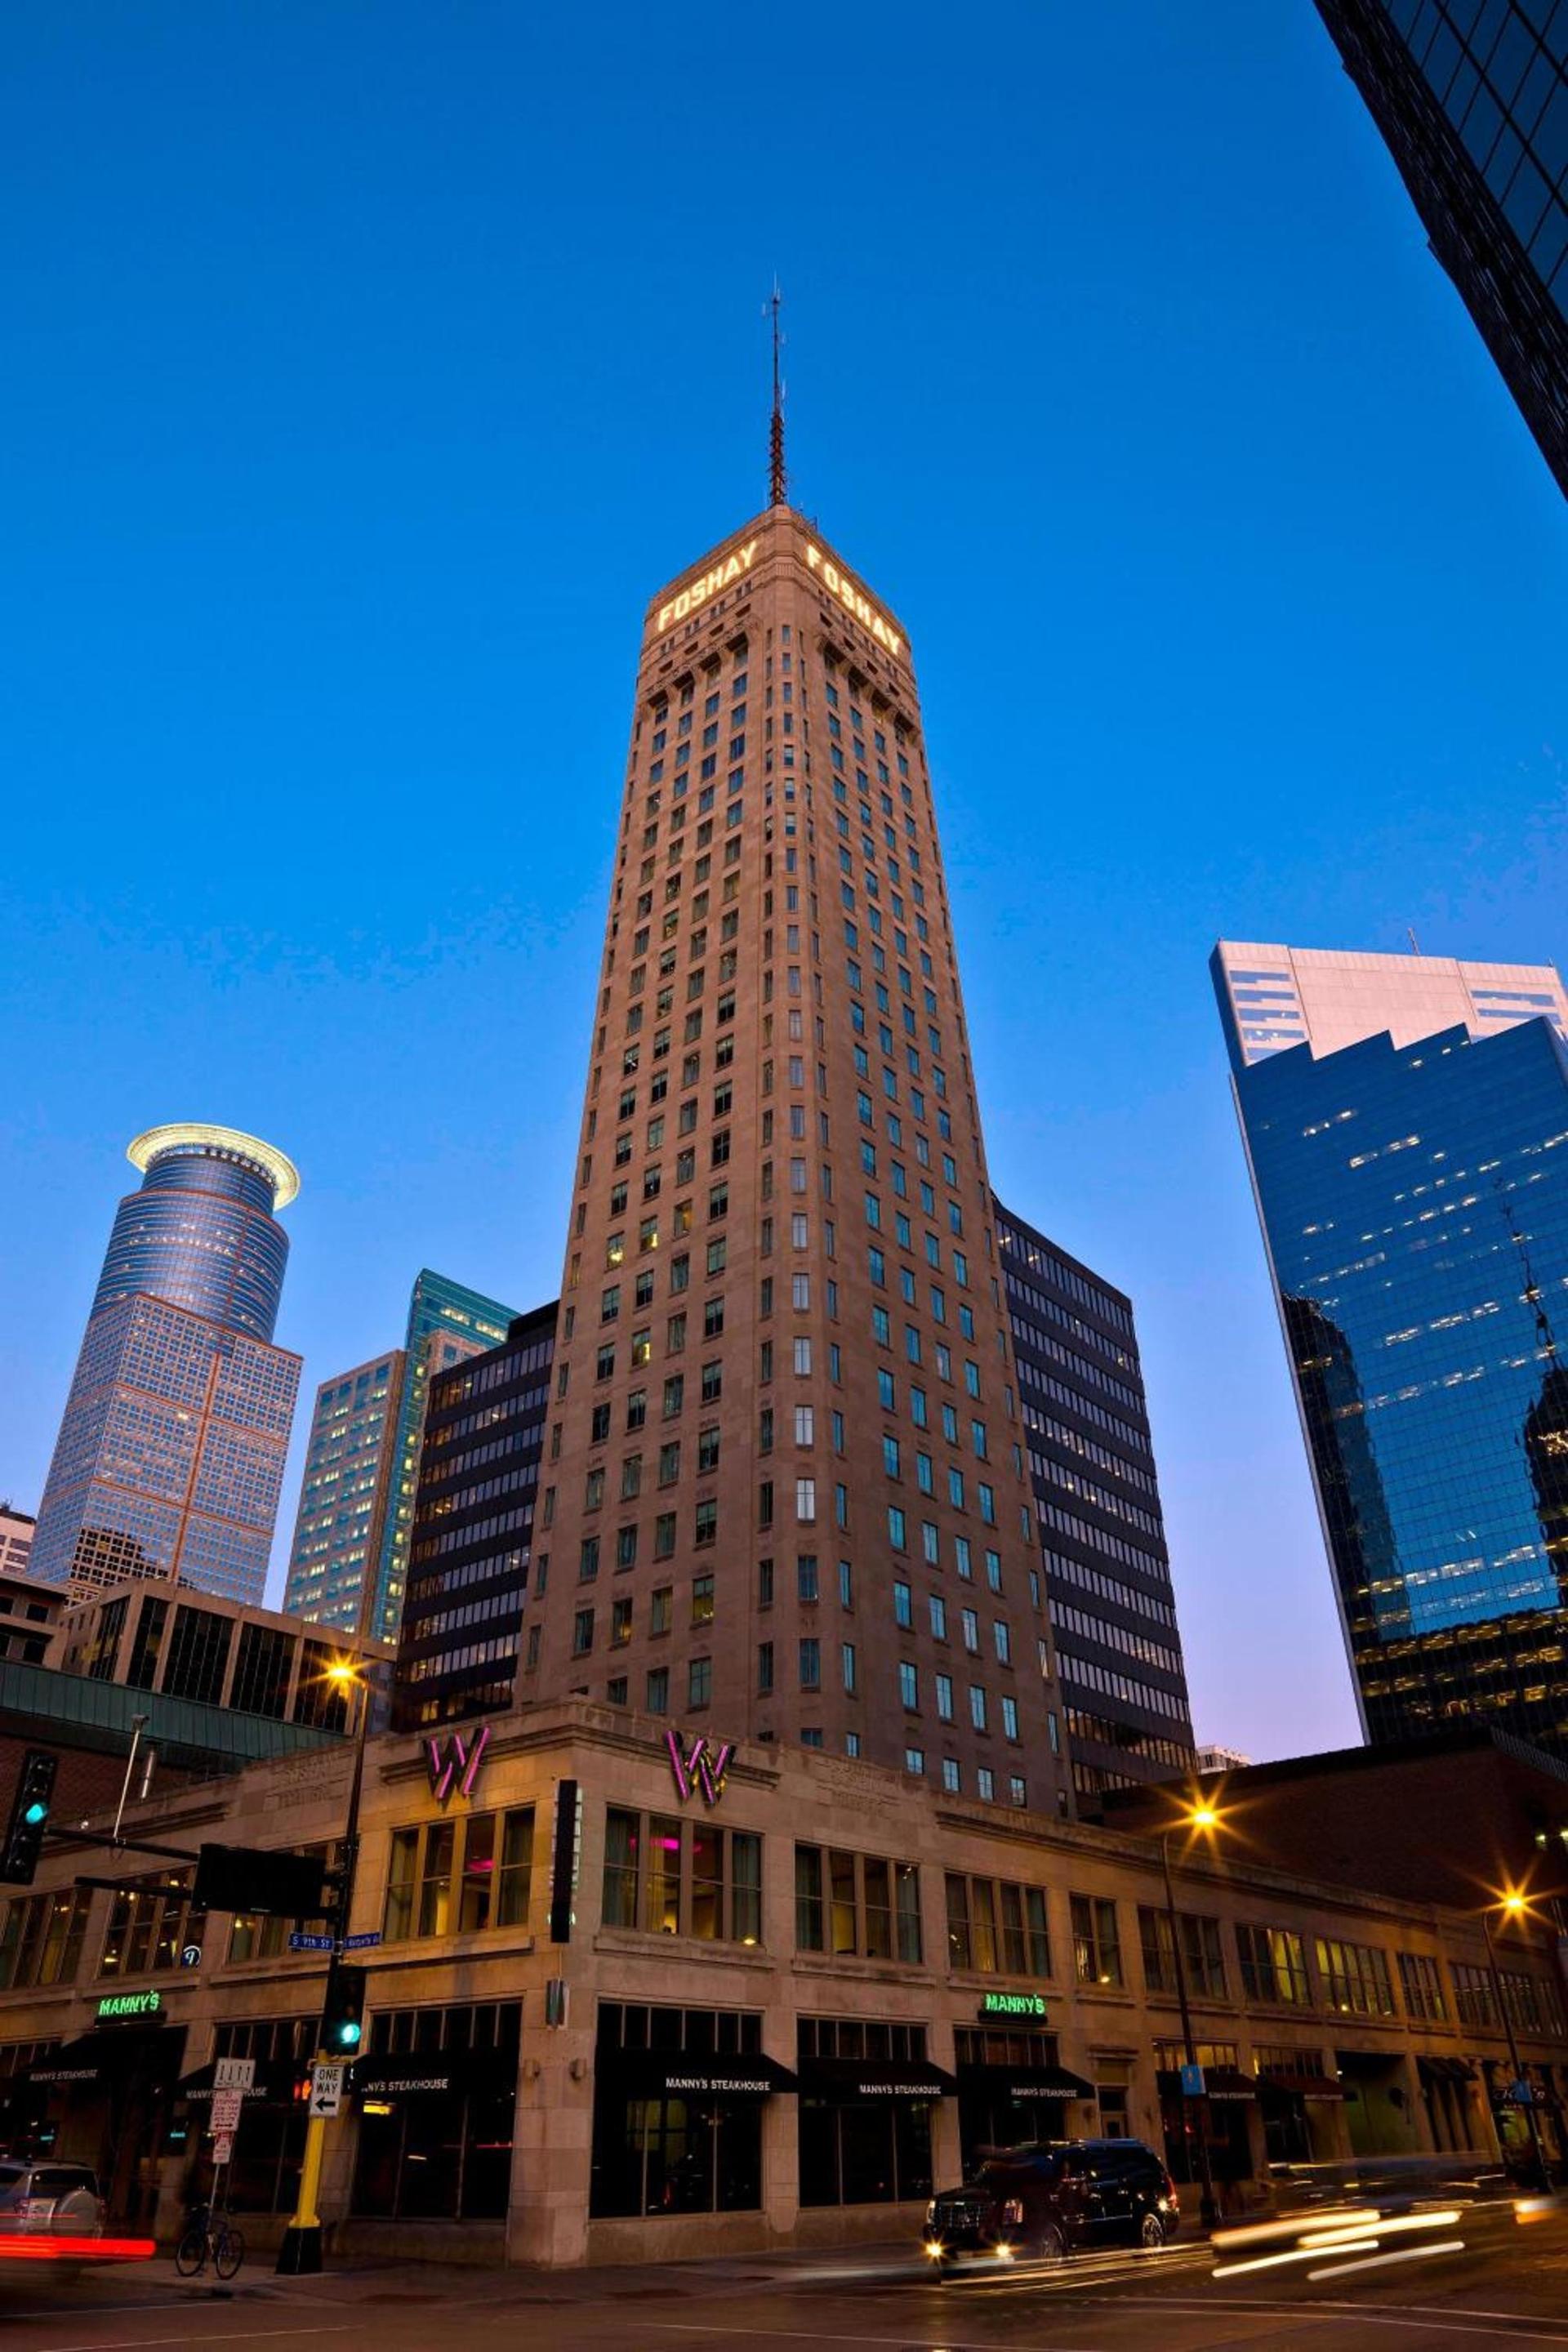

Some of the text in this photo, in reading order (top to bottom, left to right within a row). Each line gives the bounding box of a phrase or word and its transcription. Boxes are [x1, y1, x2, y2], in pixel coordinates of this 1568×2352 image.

[657, 541, 757, 632] FOSHAY
[807, 544, 900, 654] FOSHAY
[422, 1725, 490, 1806] W
[663, 1730, 737, 1808] W
[98, 1989, 160, 2015] MANNY'S
[986, 1993, 1045, 2014] MANNY'S
[319, 2069, 339, 2081] ONE
[388, 2078, 448, 2092] STEAKHOUSE
[666, 2077, 770, 2091] MANNY'S STEAKHOUSE
[315, 2082, 338, 2094] WAY
[859, 2084, 941, 2095] MANNY'S STEAKHOUSE
